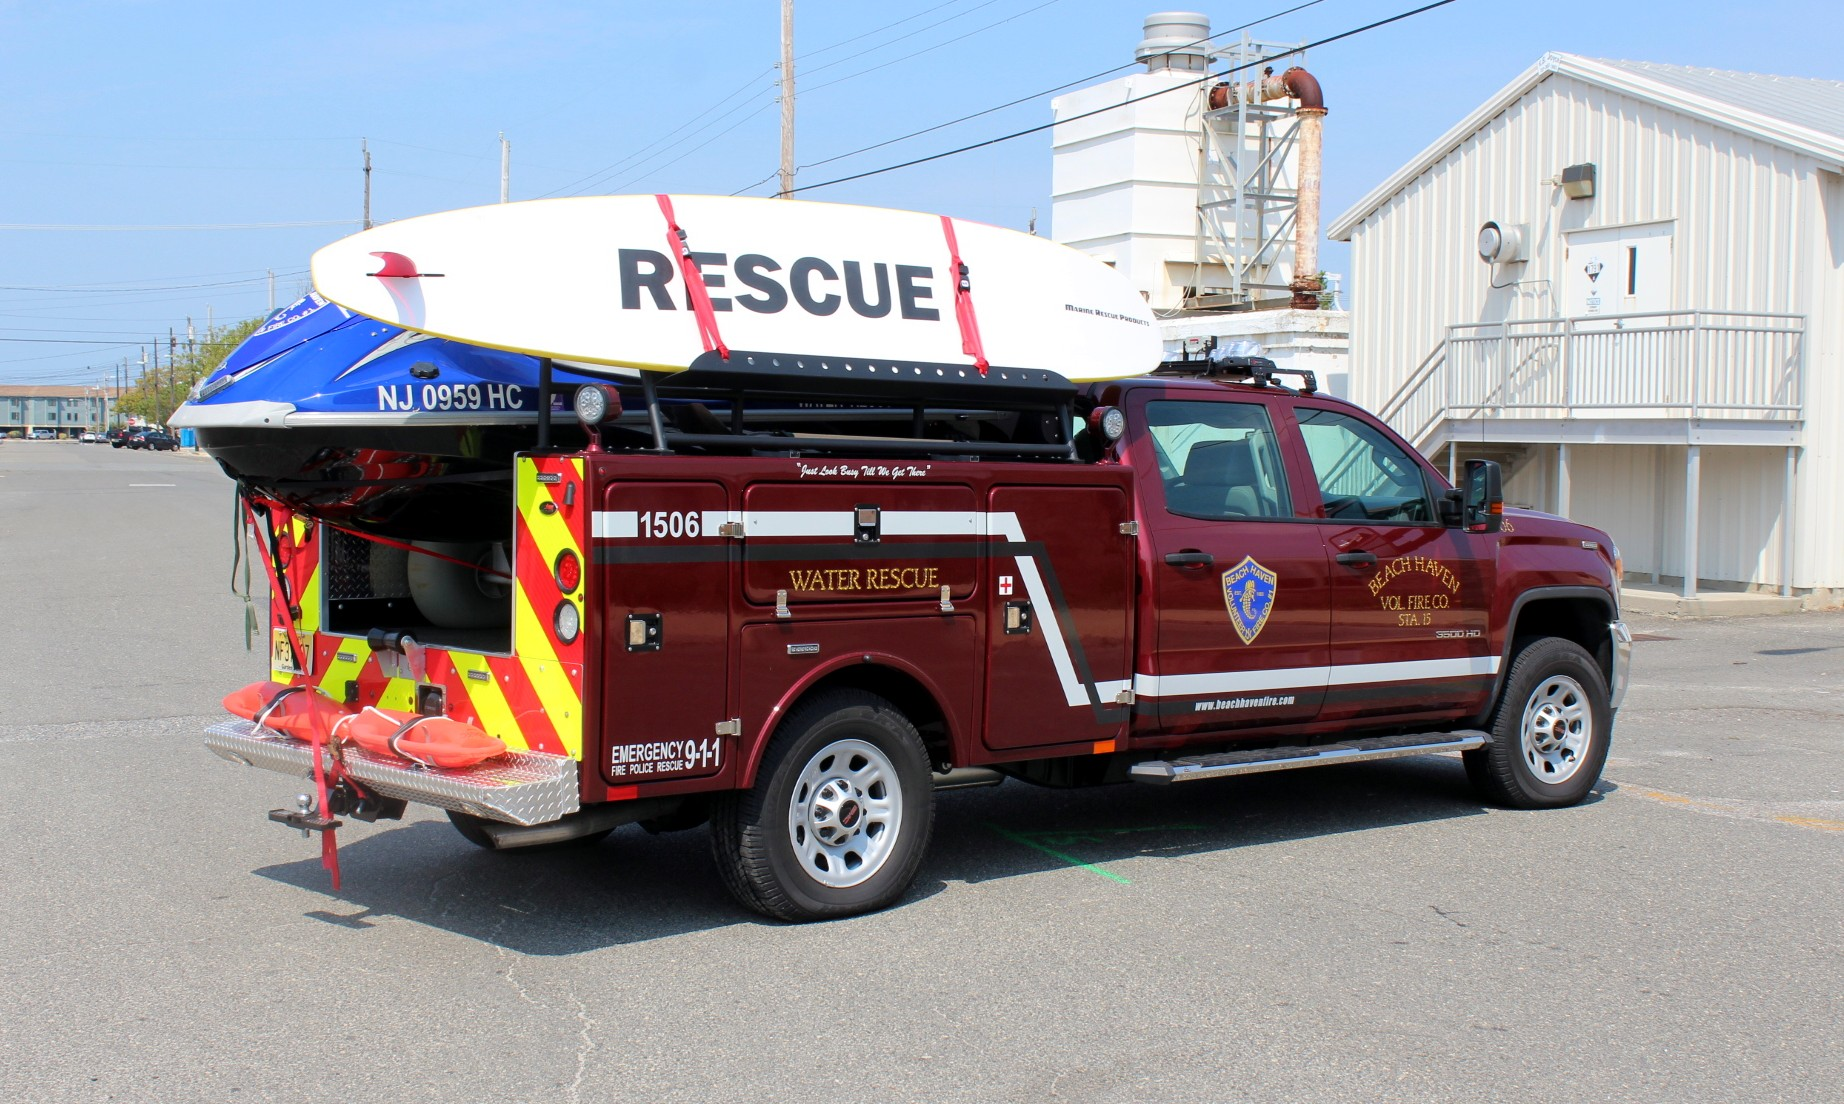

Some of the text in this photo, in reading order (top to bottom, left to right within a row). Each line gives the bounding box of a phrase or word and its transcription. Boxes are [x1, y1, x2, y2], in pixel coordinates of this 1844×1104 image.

[618, 248, 941, 322] RESCUE
[378, 384, 413, 411] NJ
[422, 384, 481, 411] 0959
[487, 383, 523, 410] HC
[818, 465, 838, 476] Look
[840, 465, 859, 478] Busy
[861, 465, 876, 476] Till
[877, 465, 890, 476] We
[891, 466, 905, 480] Get
[640, 511, 700, 538] 1506
[788, 567, 940, 591] WATER RESCUE
[1225, 565, 1274, 586] BEACH HAVEN
[1368, 556, 1460, 597] BEACH HAVEN
[1226, 587, 1246, 634] VOLUNTEER
[1252, 615, 1265, 634] FIRE
[1407, 594, 1431, 610] FIRE
[1432, 594, 1450, 609] CO.
[1398, 612, 1432, 627] STA. 15
[1435, 629, 1481, 639] 3500 HD
[1194, 695, 1295, 711] www.beachhavenfire.com
[611, 738, 720, 769] EMERGENCY 9-1-1
[611, 760, 684, 777] FIRE POLICE RESCUE
